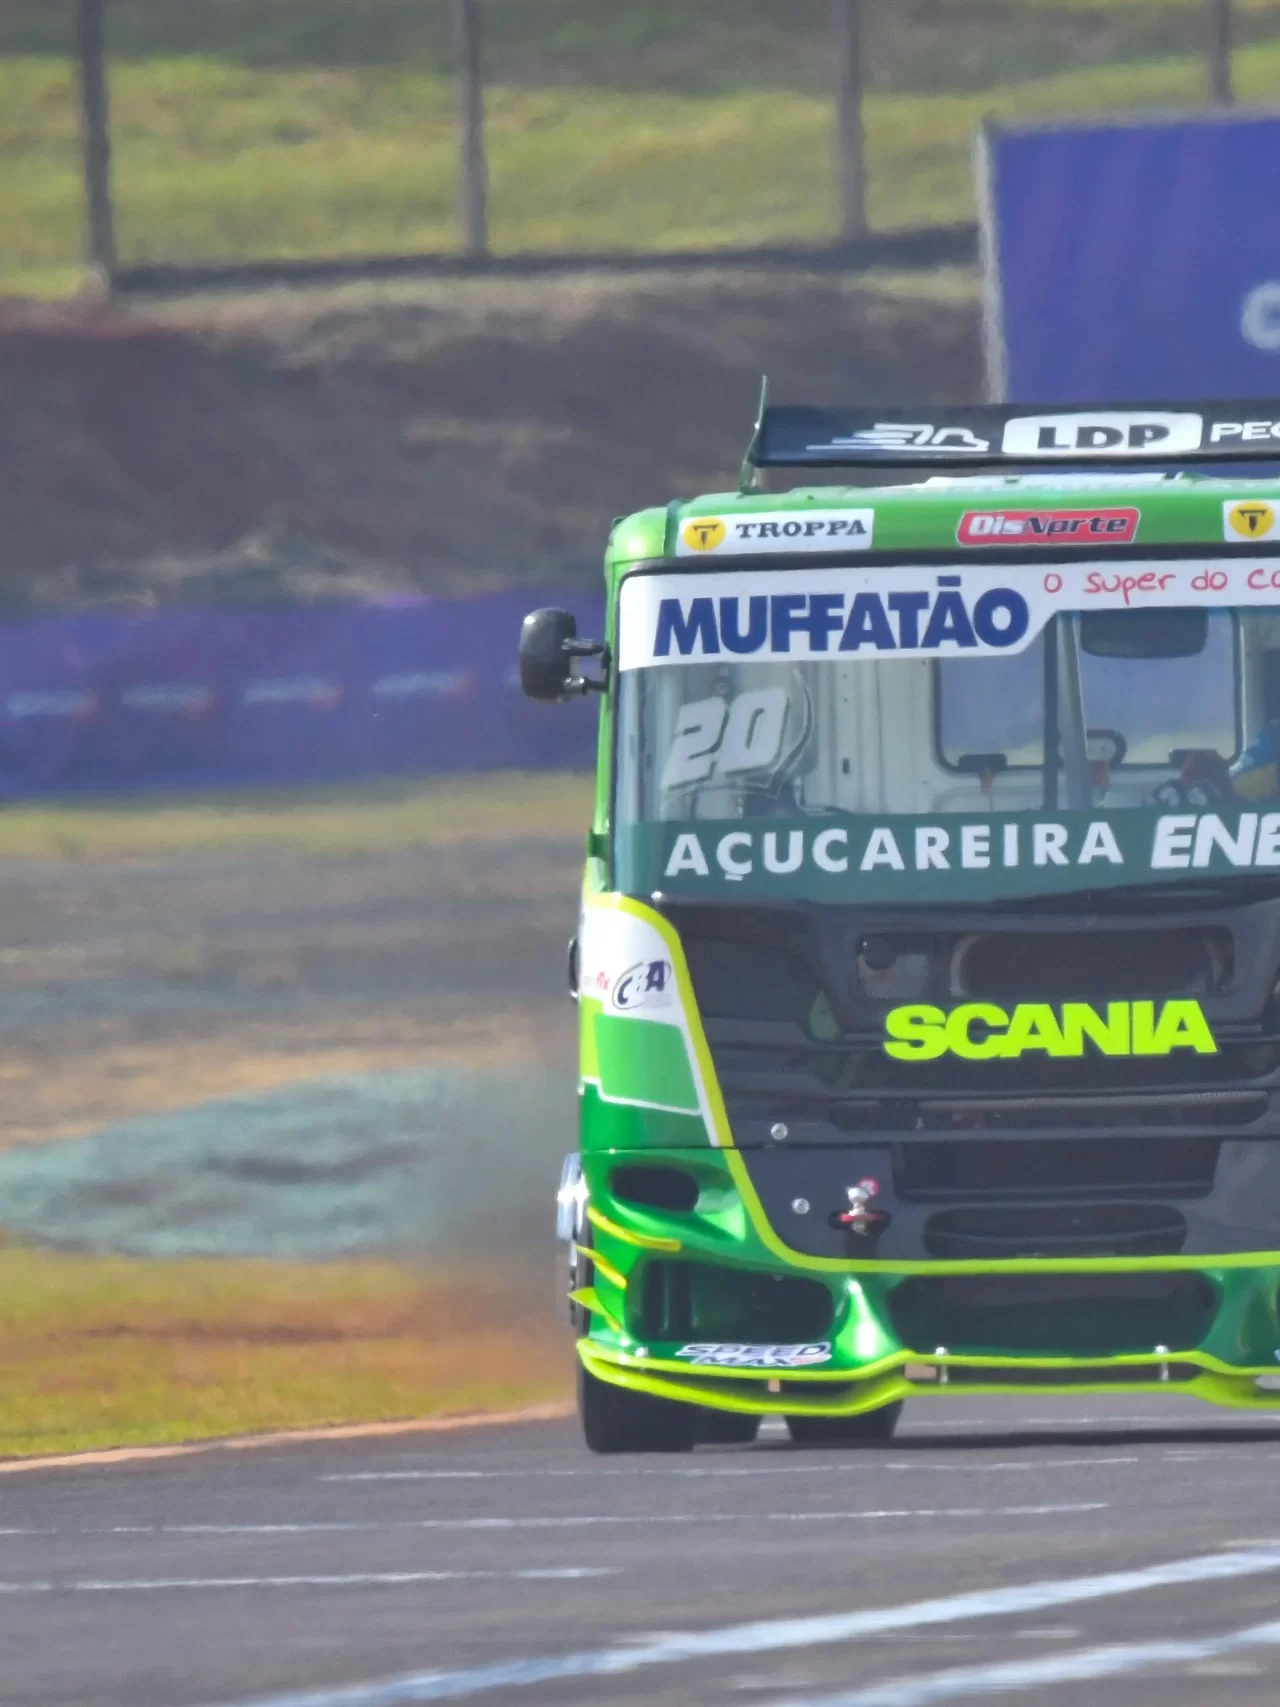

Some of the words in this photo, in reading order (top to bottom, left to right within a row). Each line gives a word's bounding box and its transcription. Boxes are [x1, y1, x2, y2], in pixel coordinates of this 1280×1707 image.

[1036, 423, 1172, 450] LDP
[735, 519, 867, 539] TROPPA
[653, 575, 1030, 657] MUFFATÃO
[1083, 572, 1177, 606] super
[1191, 568, 1229, 591] do
[659, 687, 789, 792] 20
[664, 820, 1124, 881] AÇUCAREIRA
[883, 999, 1219, 1062] SCANIA
